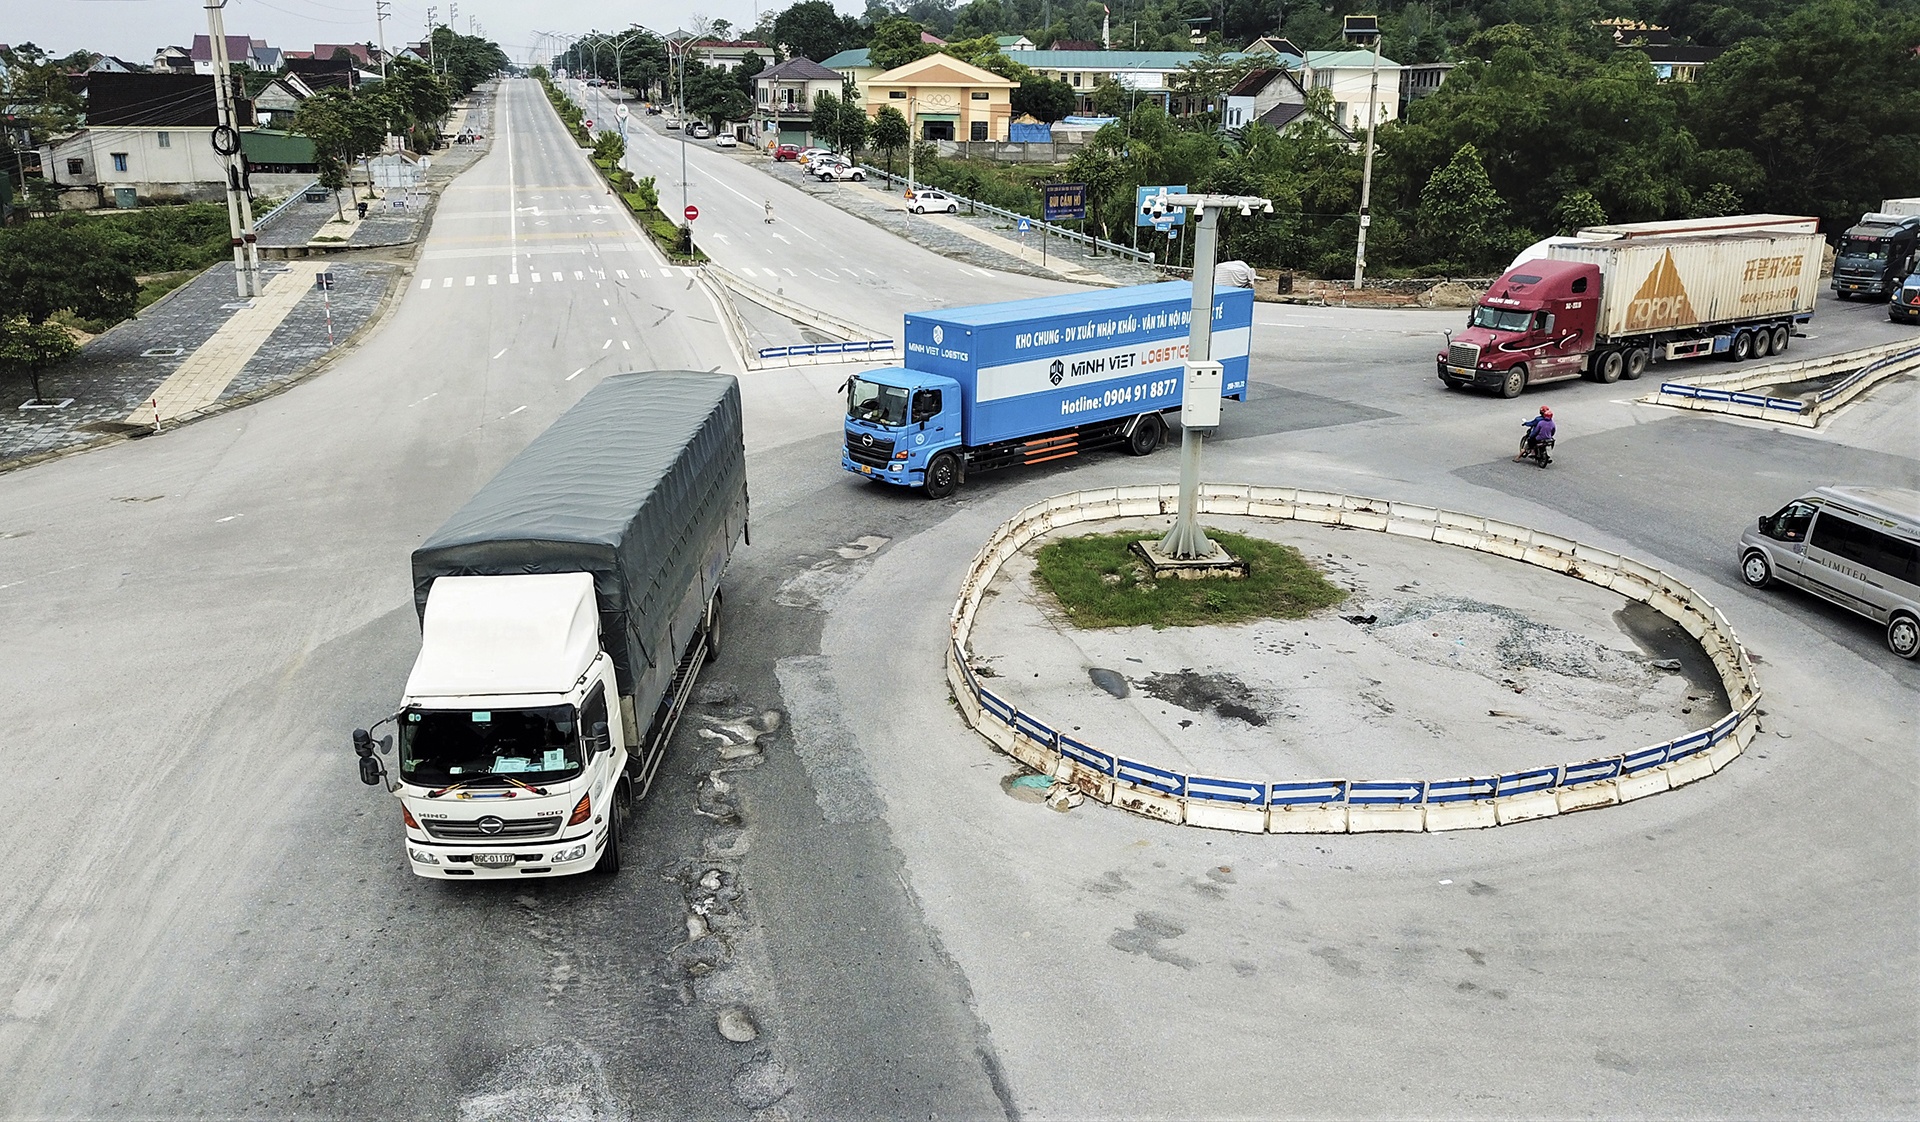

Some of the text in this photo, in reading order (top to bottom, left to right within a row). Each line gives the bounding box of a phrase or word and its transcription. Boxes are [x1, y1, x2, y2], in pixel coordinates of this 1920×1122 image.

[1015, 332, 1032, 349] KHO
[1033, 329, 1060, 347] CHUNG
[1065, 327, 1076, 342] DV
[1077, 320, 1096, 340] XUẤT
[1096, 319, 1117, 340] NHẬP
[1142, 313, 1155, 334] VẬN
[1168, 310, 1181, 330] NỘI
[941, 349, 969, 362] LOGISTICS
[1061, 378, 1178, 415] Hotline: 0904 91 8877
[1821, 557, 1867, 582] LIMITED
